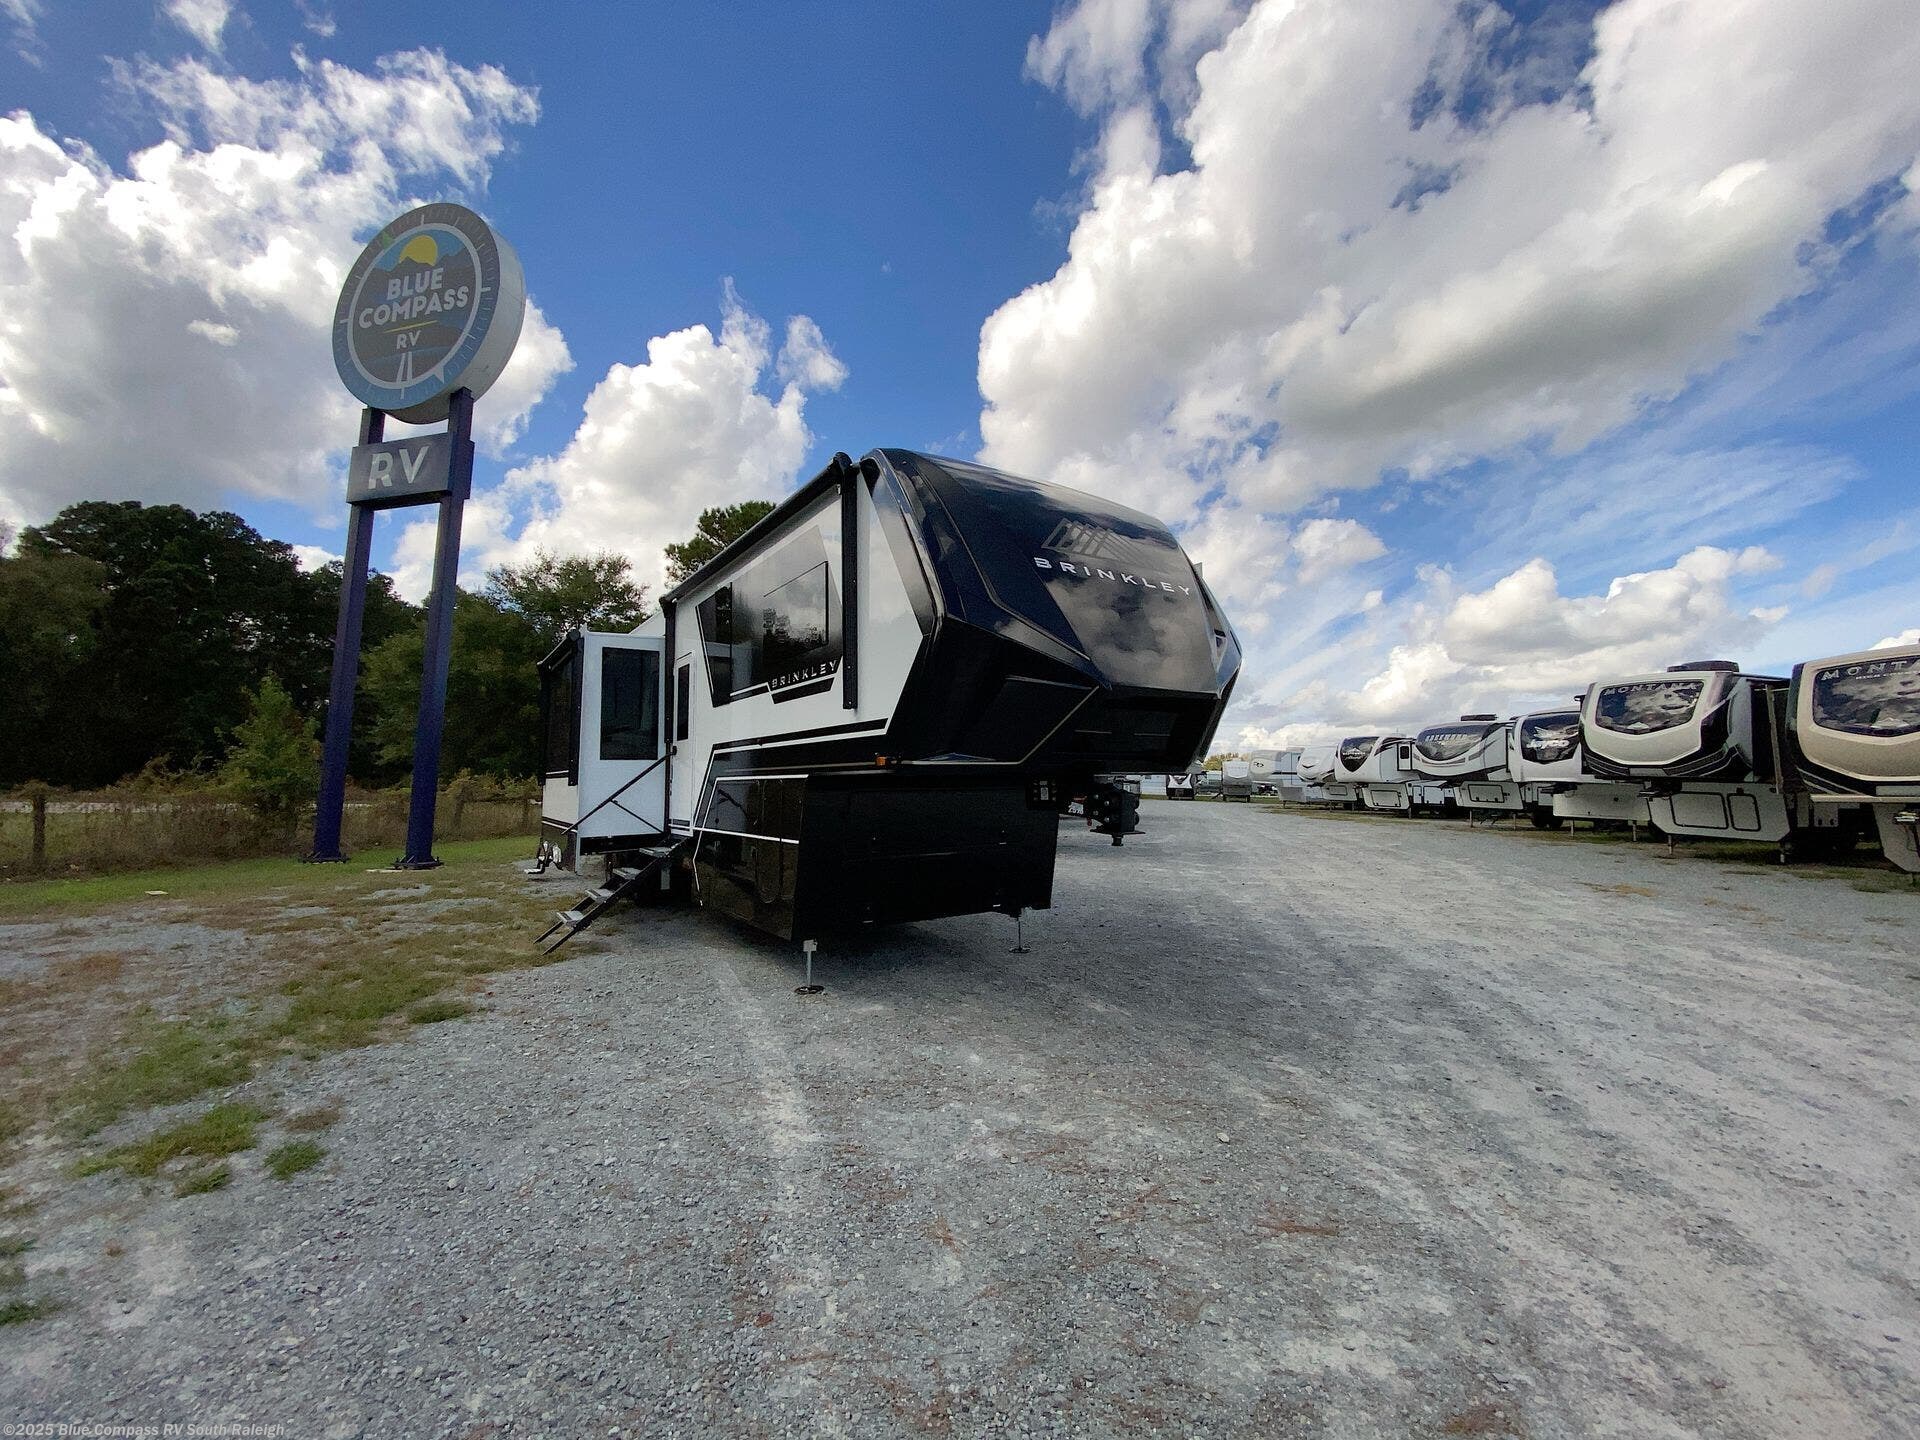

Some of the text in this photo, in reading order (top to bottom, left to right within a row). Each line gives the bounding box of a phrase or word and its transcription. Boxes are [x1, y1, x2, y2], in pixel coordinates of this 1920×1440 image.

[386, 268, 444, 300] BLUE
[358, 288, 470, 329] COMPASS
[396, 330, 422, 350] RV
[368, 446, 429, 490] RV
[1033, 556, 1190, 596] BRINKLEY
[771, 659, 837, 689] BRINKLEY
[1603, 683, 1697, 696] MONTANA
